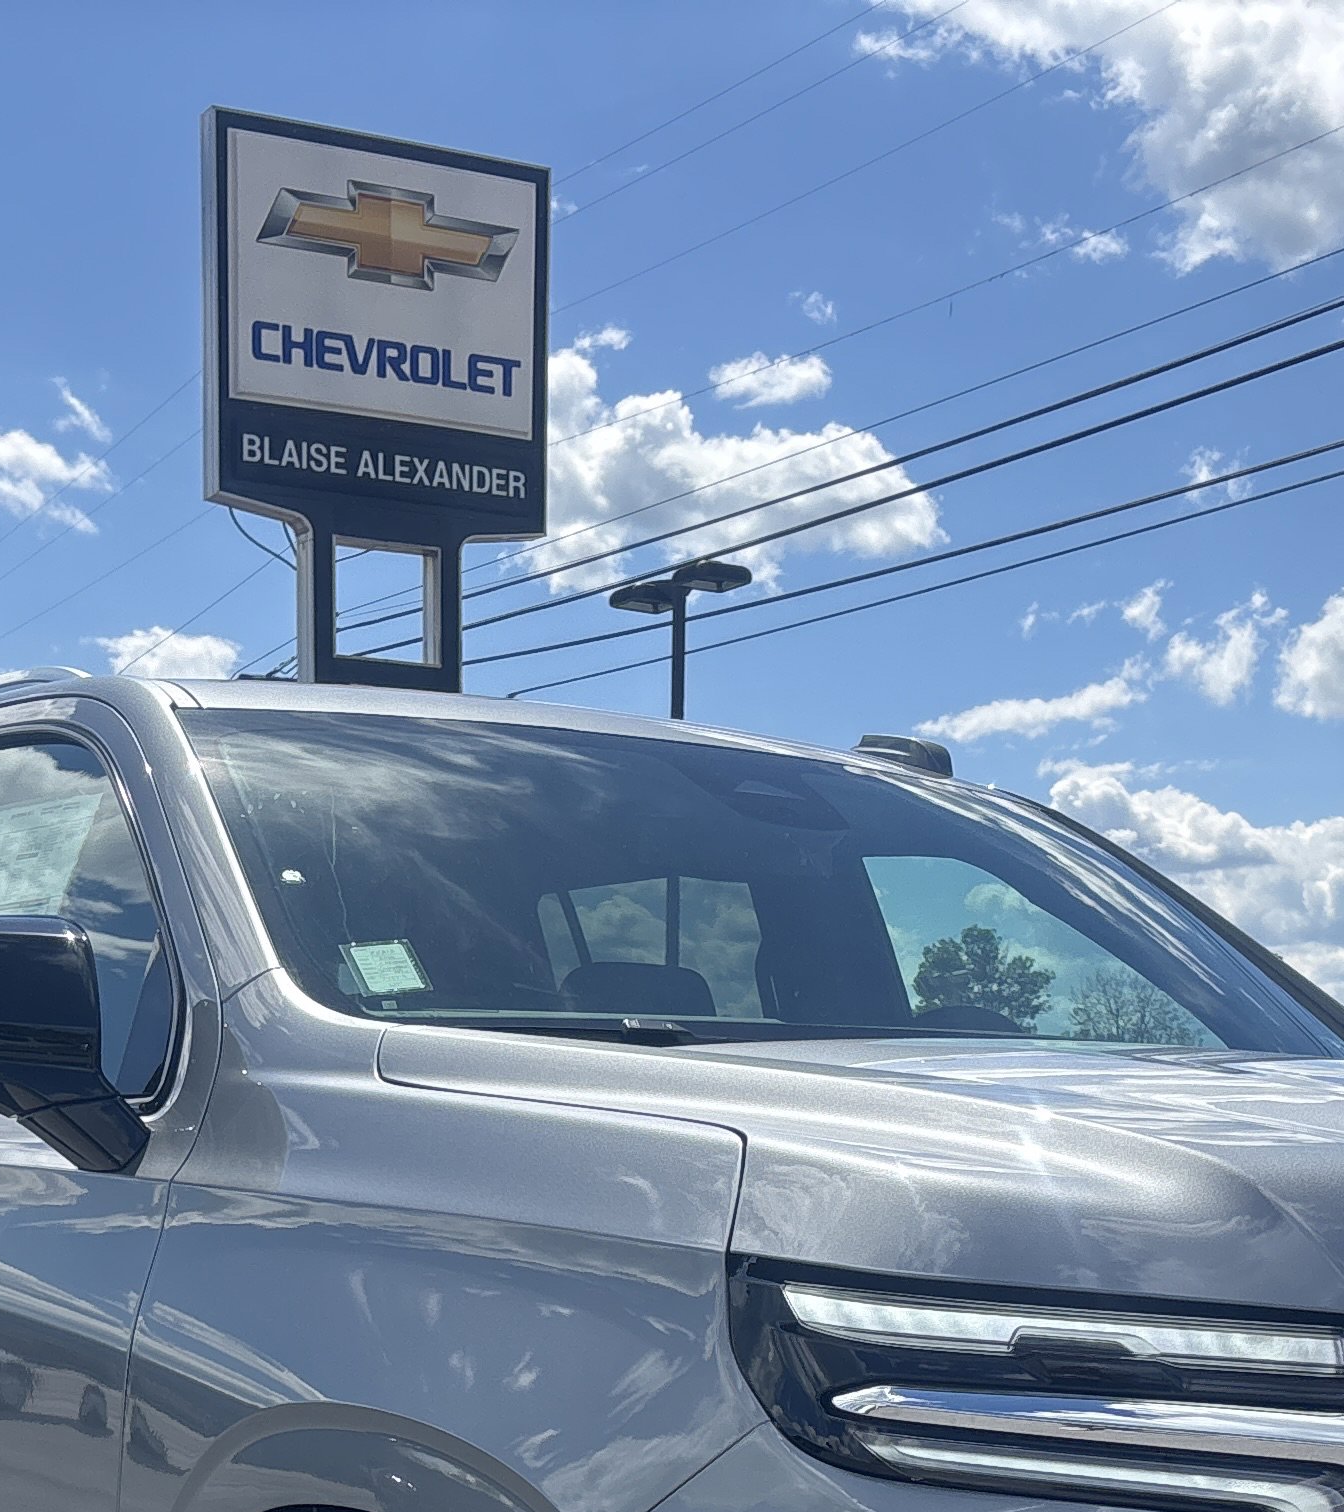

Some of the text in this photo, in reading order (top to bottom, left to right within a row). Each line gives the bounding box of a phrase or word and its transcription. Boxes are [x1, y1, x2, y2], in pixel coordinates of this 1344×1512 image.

[250, 320, 521, 398] CHEVROLET
[241, 432, 527, 500] BLAISE ALEXANDER
